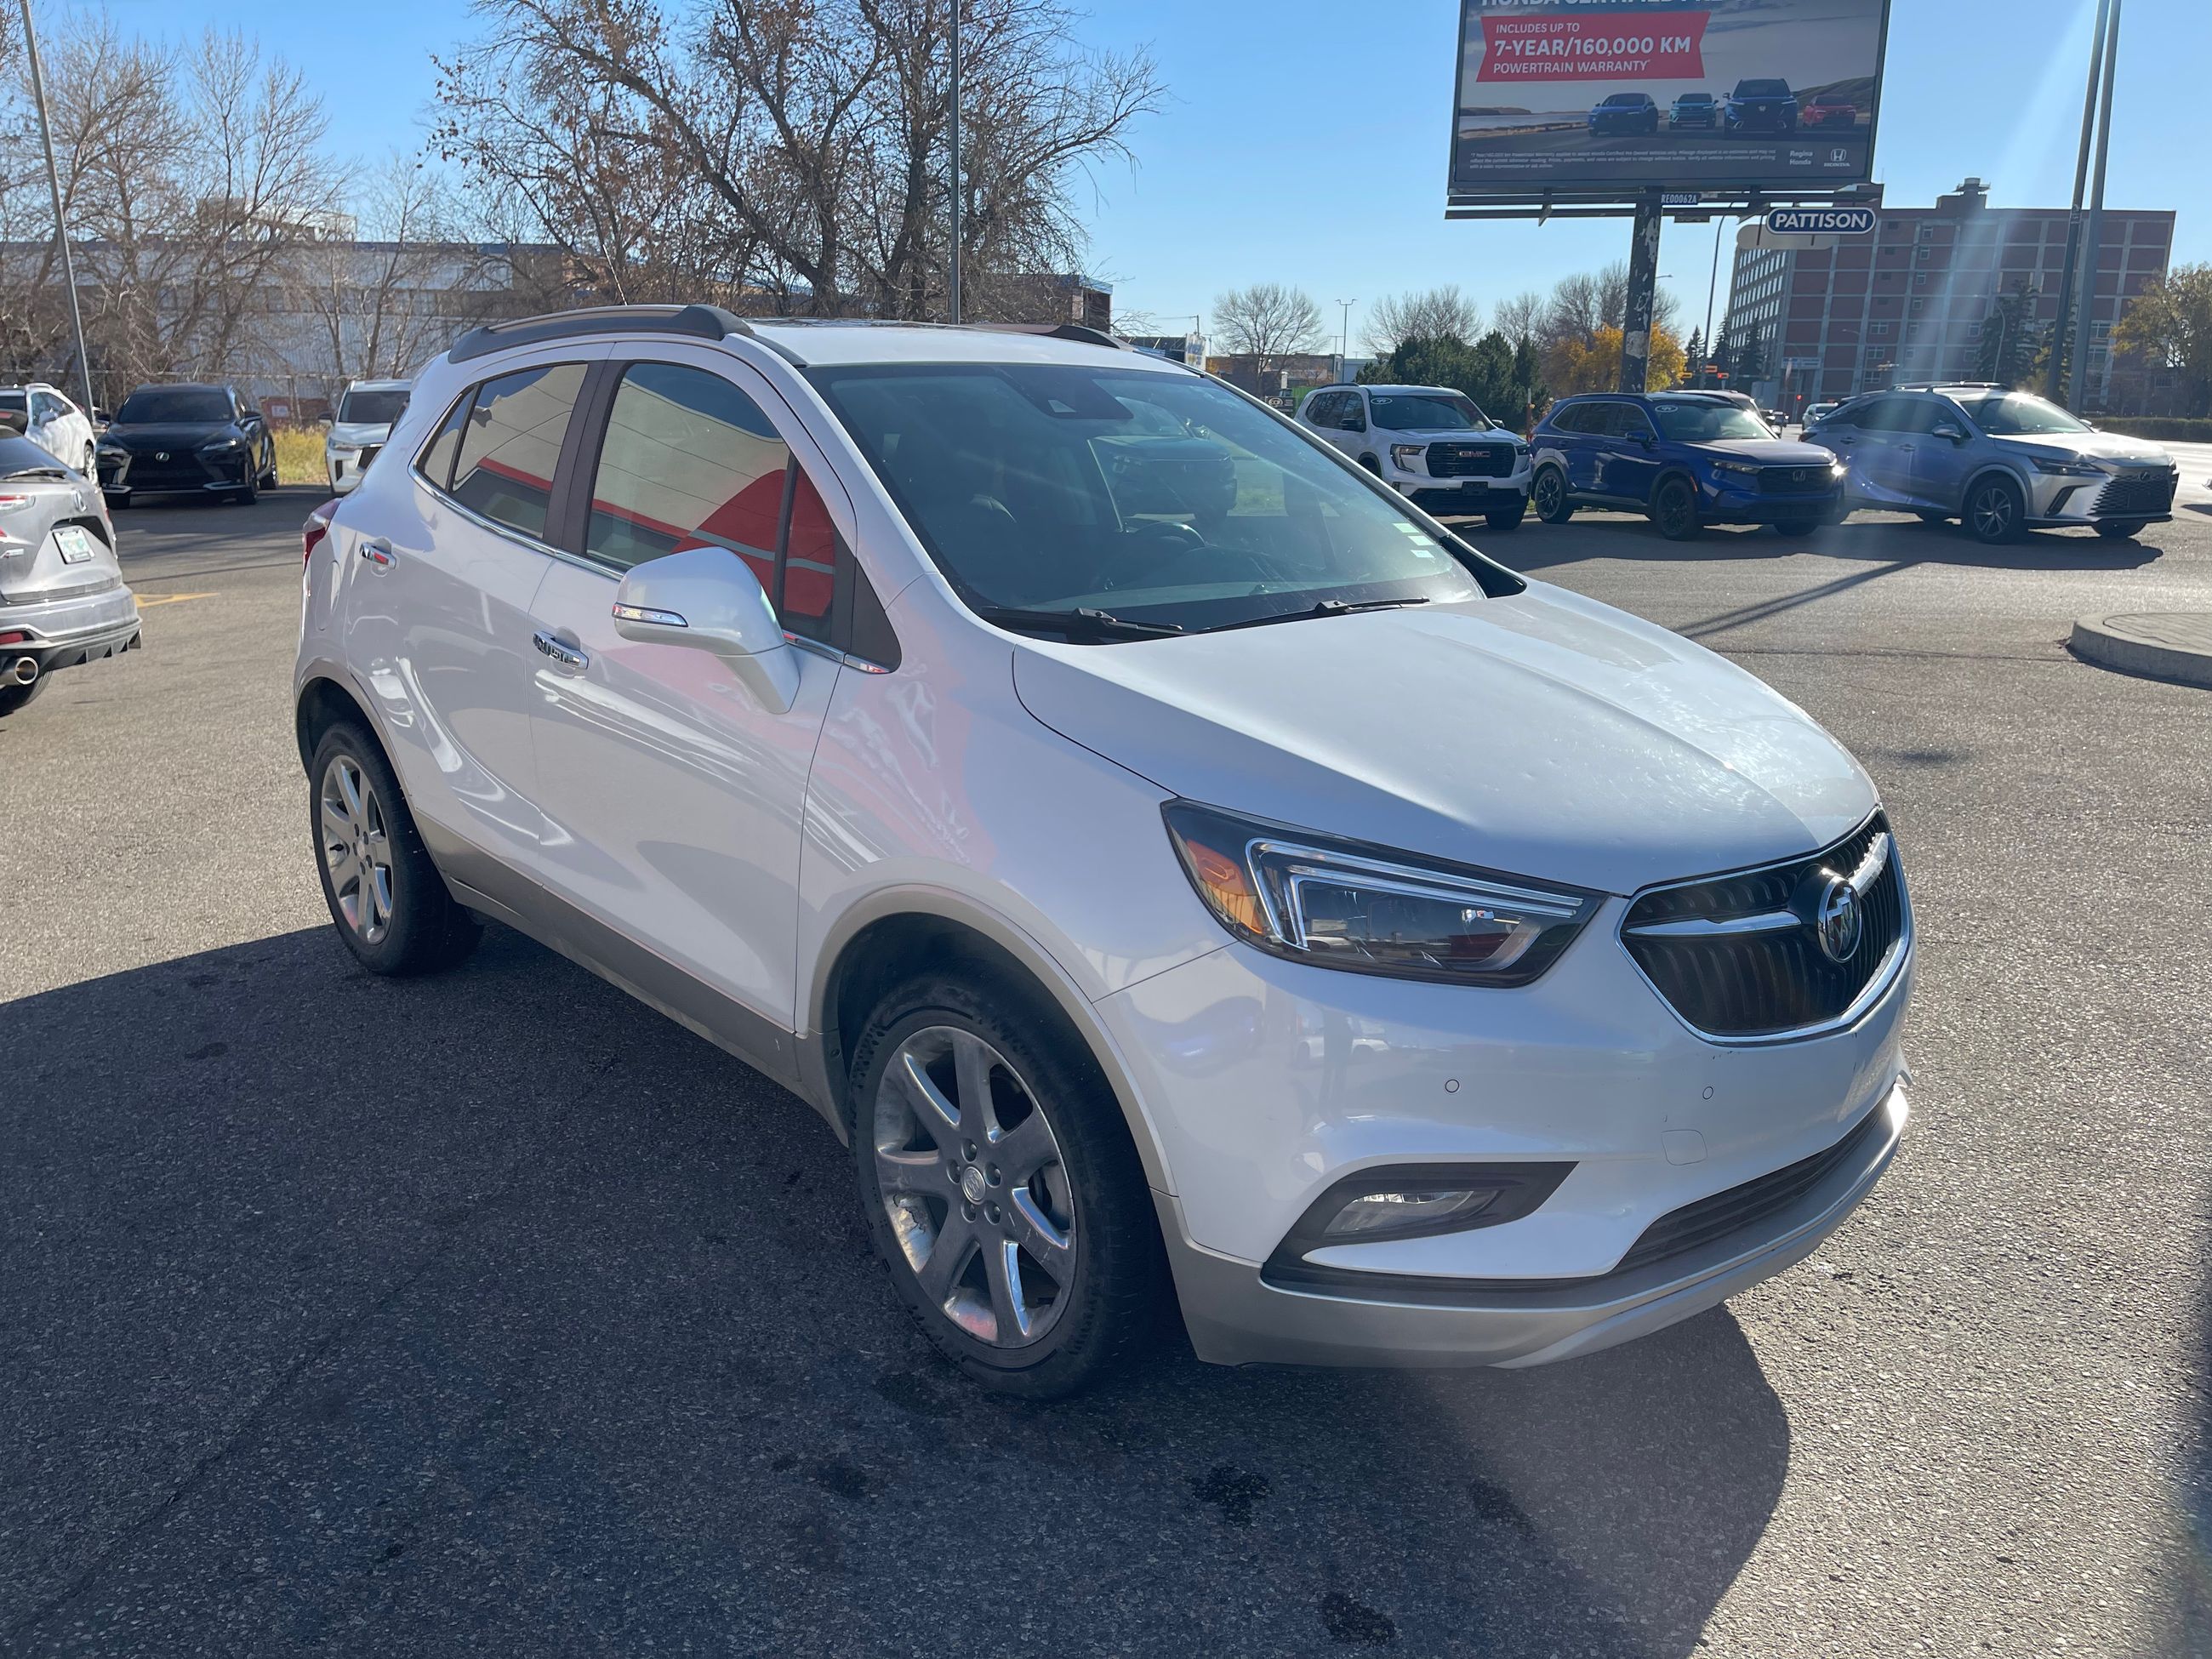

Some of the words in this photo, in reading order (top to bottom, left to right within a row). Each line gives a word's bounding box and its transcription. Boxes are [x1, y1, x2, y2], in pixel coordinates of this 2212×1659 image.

[1496, 23, 1548, 34] INCLUDES
[1549, 23, 1564, 33] UP
[1566, 22, 1580, 32] TO
[1494, 37, 1655, 57] 7-YEAR/160,000
[1660, 36, 1691, 54] KM
[1493, 61, 1573, 74] POWERTRAIN
[1661, 194, 1697, 203] RE00062A
[1775, 213, 1867, 228] PATTISON
